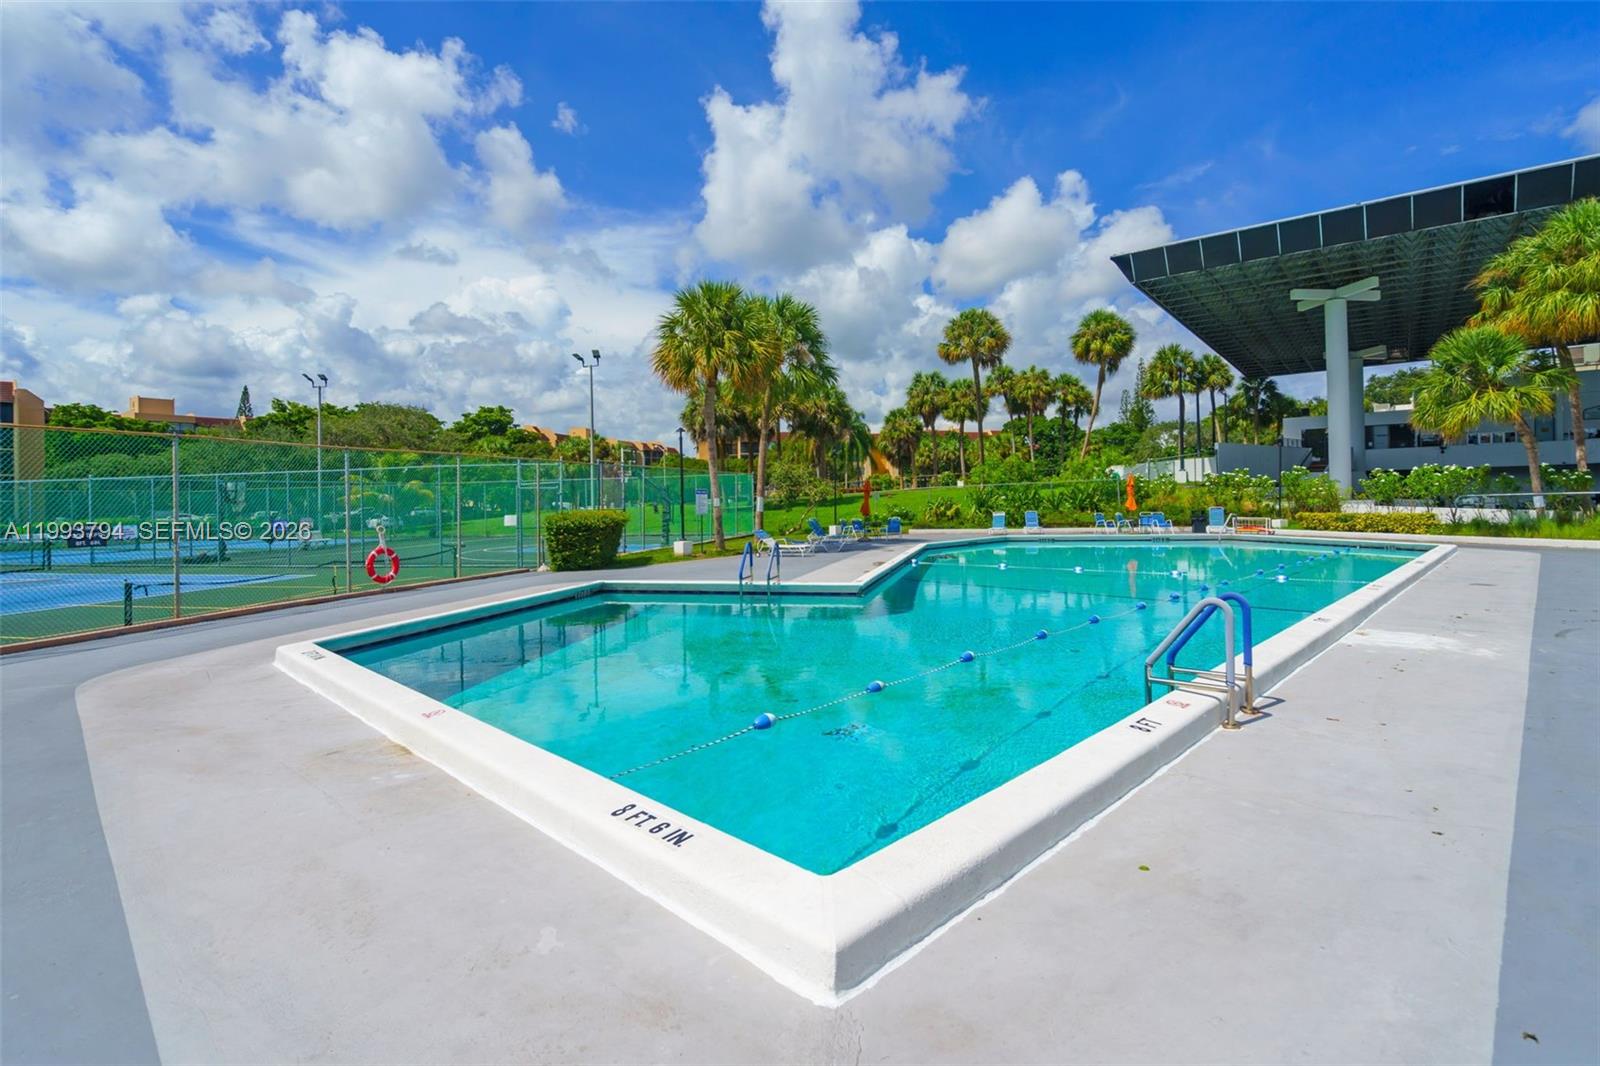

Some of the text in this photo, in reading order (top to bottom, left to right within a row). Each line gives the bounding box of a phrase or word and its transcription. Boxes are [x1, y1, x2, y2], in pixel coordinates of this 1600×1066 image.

[1129, 724, 1151, 732] 8
[610, 803, 695, 848] 8 FT. 6 IN.
